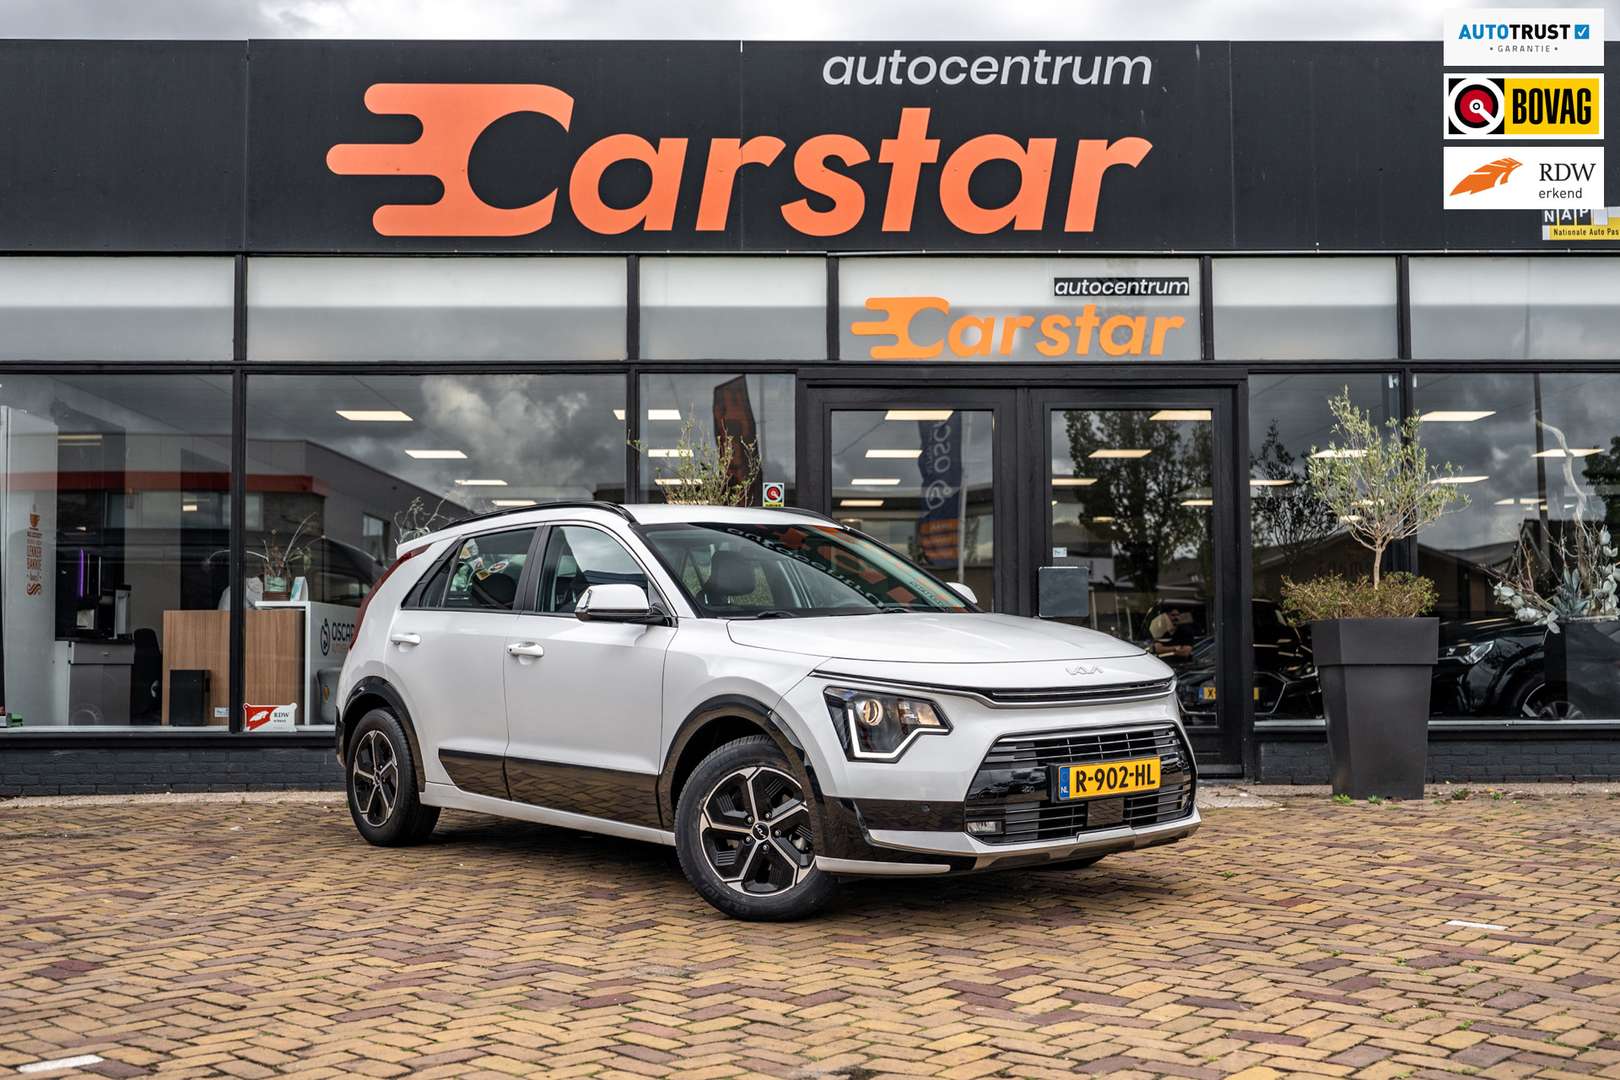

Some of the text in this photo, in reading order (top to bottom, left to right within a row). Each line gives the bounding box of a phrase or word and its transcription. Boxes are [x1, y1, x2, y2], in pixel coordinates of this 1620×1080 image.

[822, 48, 1152, 86] autocentrum
[326, 83, 1153, 237] Carstar
[1553, 227, 1619, 236] Nationale Auto Pas
[1054, 278, 1189, 295] autocentrum
[850, 296, 1185, 359] Carstar
[1060, 786, 1069, 794] NL
[1075, 763, 1156, 793] R-902-HL
